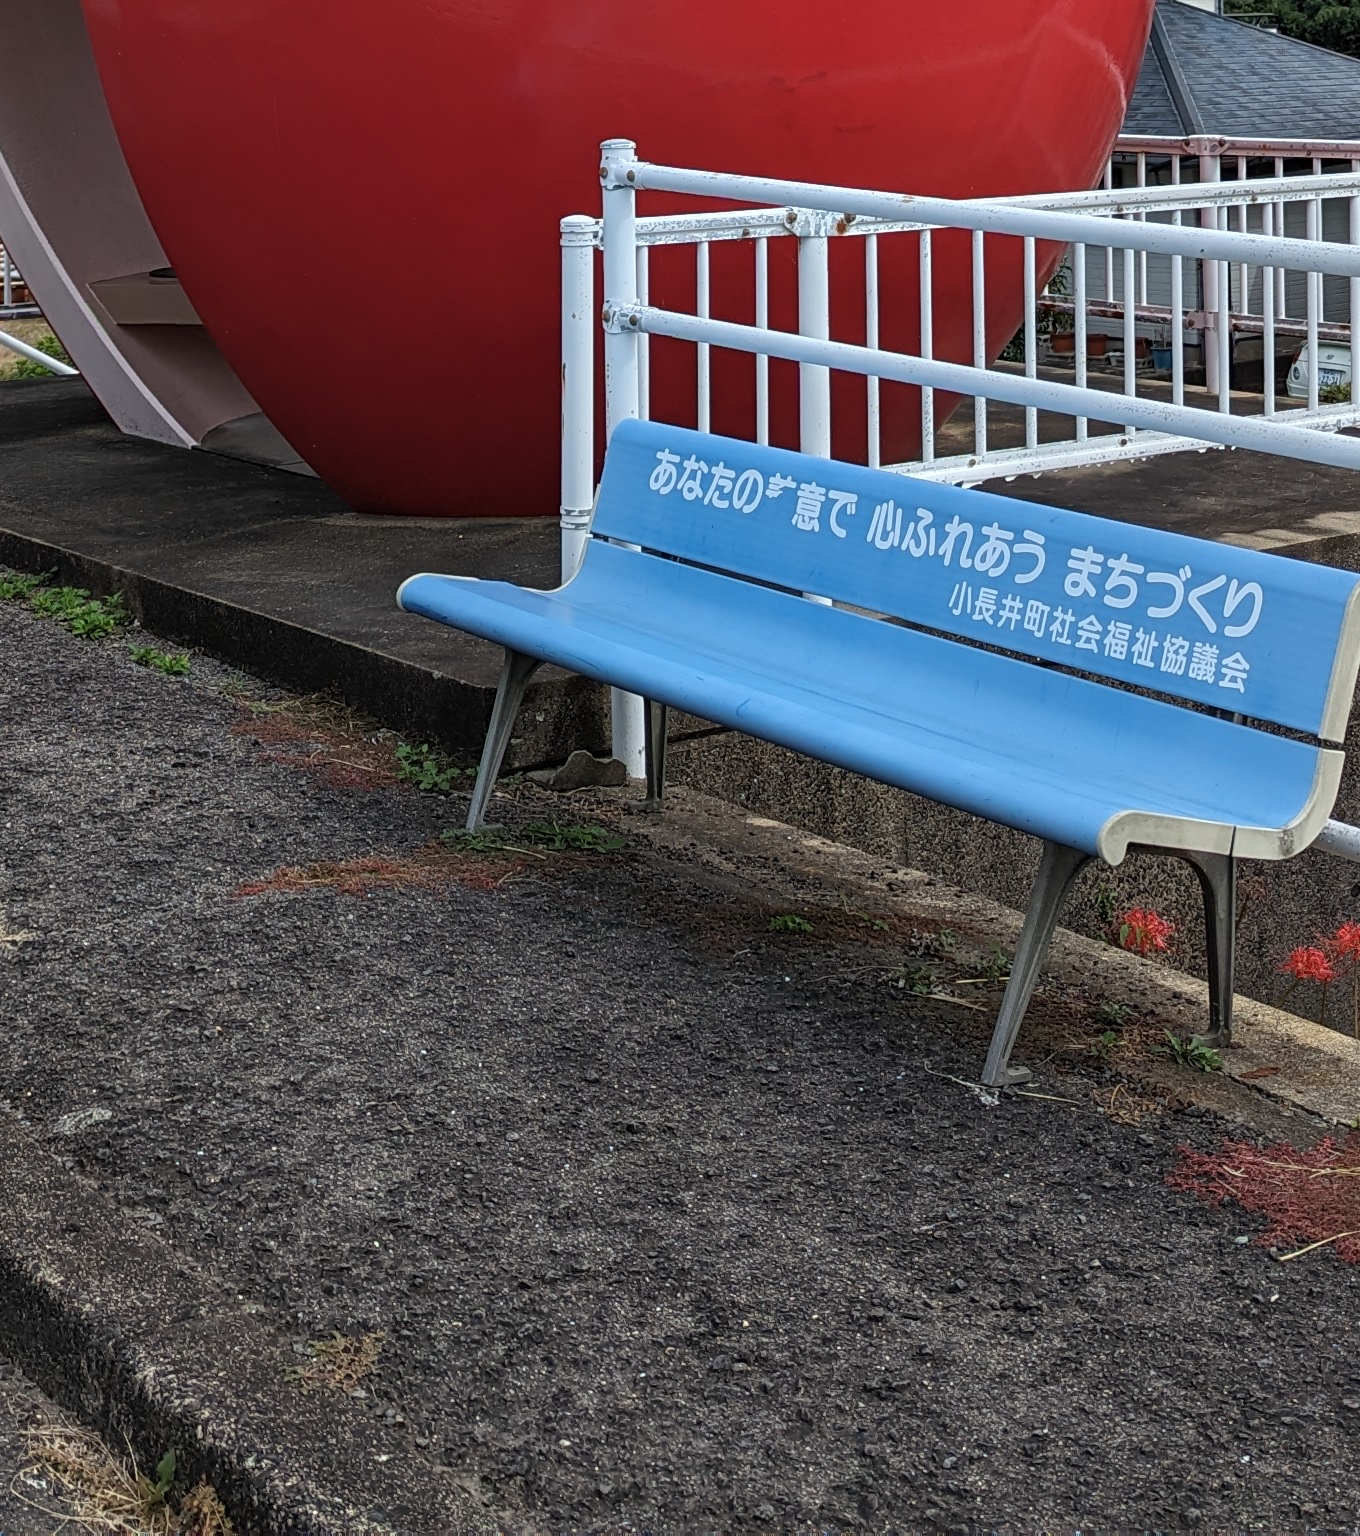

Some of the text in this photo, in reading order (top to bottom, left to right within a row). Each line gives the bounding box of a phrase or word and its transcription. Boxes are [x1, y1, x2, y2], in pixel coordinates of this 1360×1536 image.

[866, 499, 1047, 585] 心ふれあう
[1062, 545, 1264, 639] まちづくり
[947, 580, 1252, 695] 小長井町社会福祉協議会
